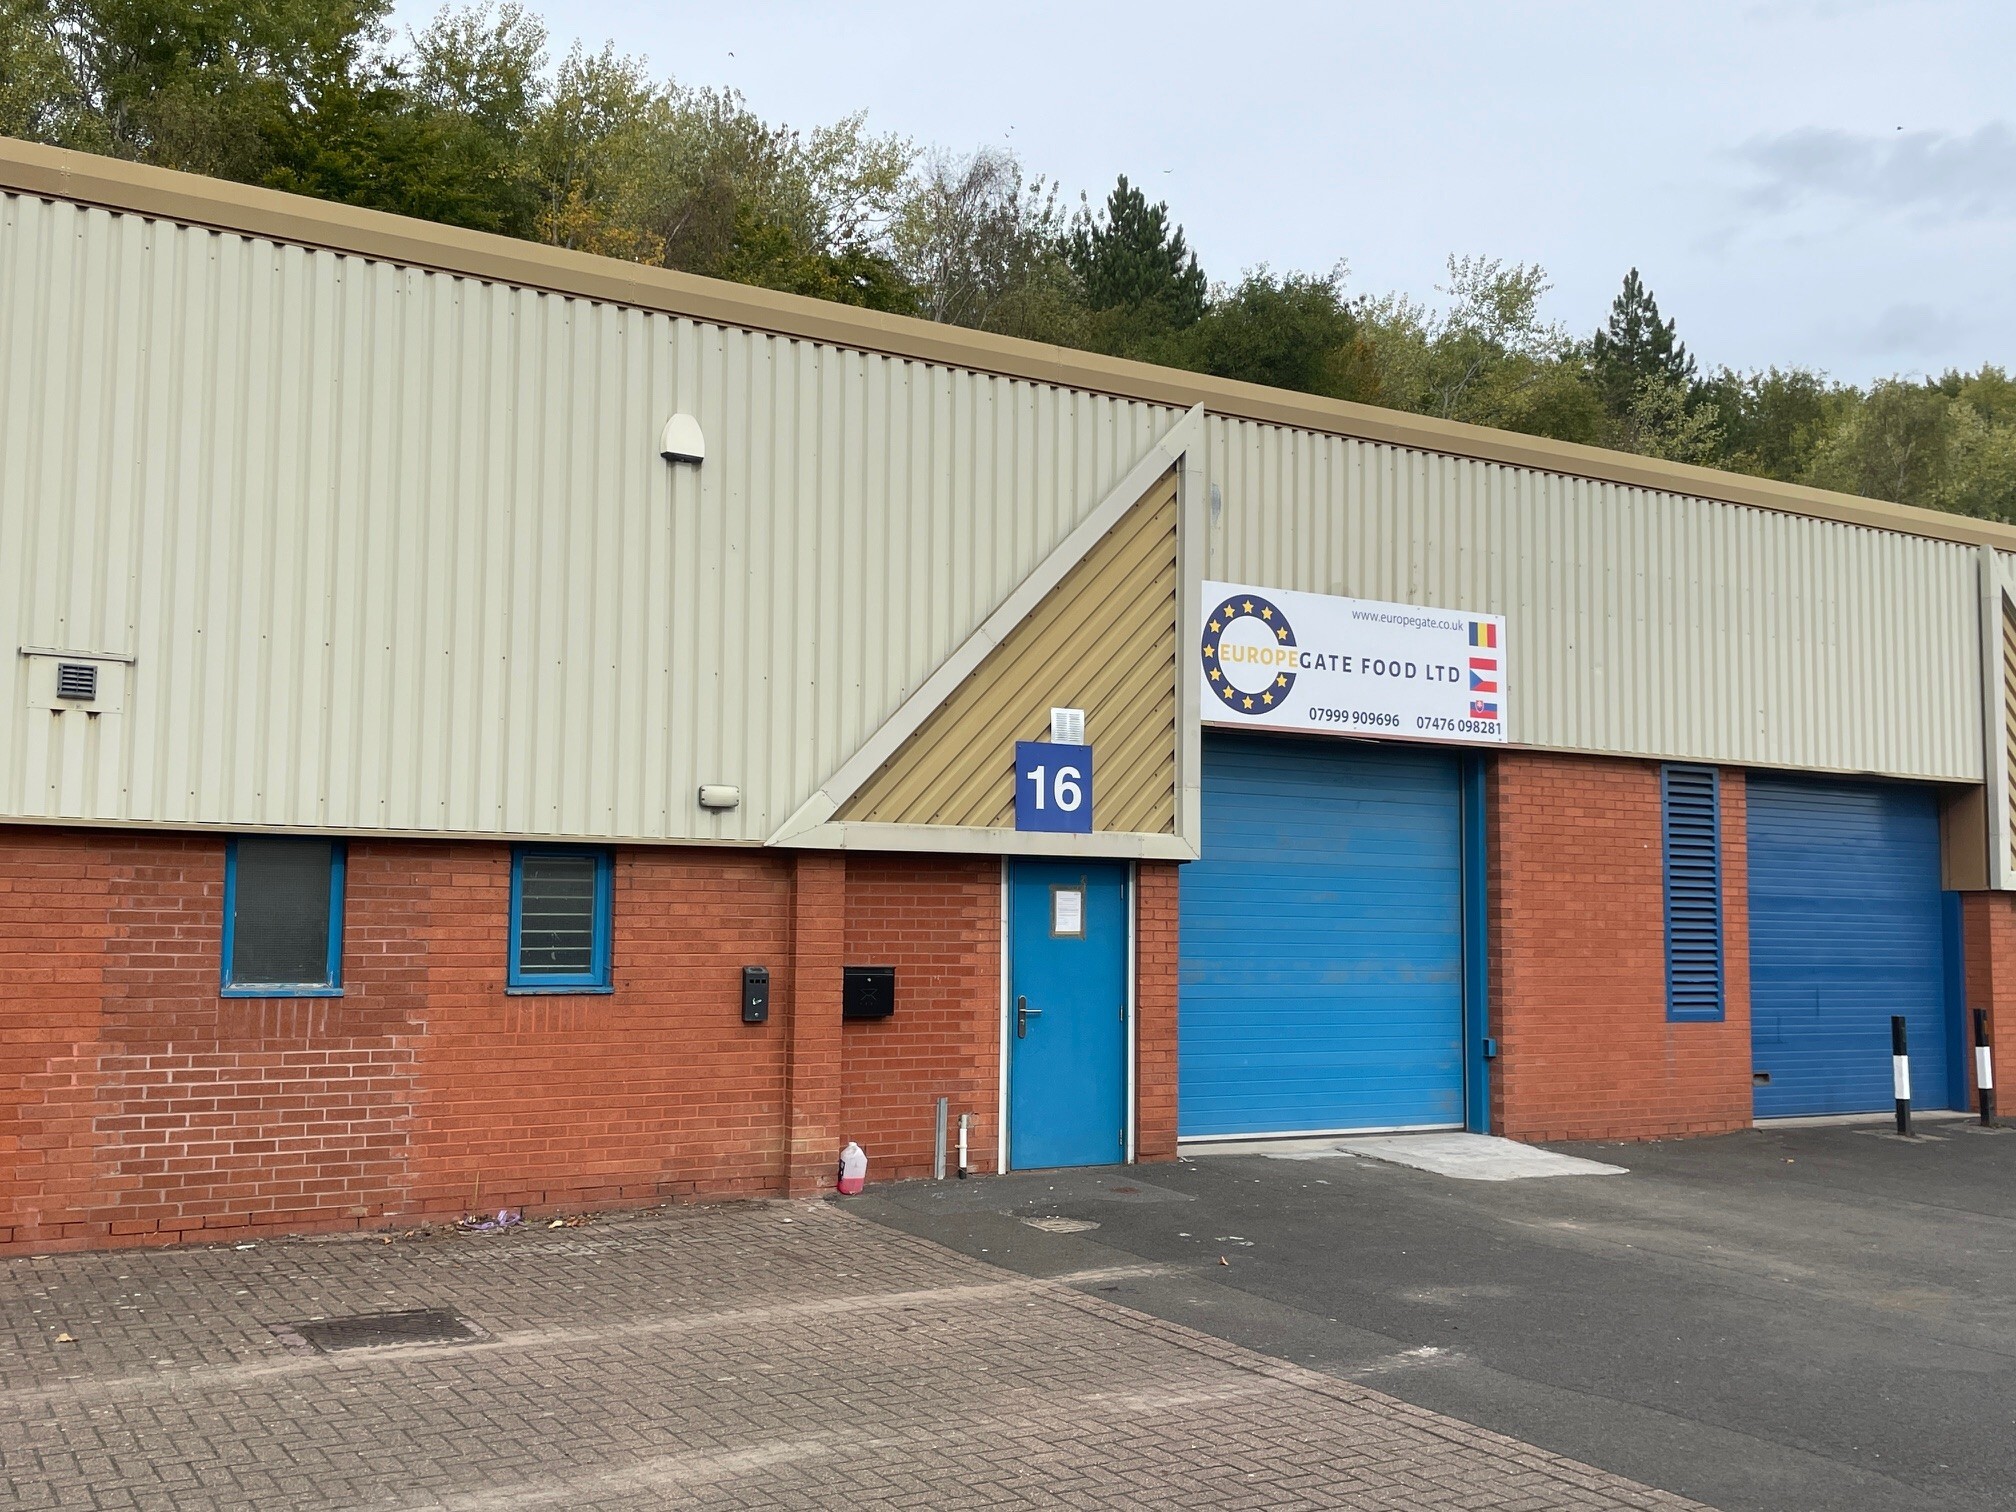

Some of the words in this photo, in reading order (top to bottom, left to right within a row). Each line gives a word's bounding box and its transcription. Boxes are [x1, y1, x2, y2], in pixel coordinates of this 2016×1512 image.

[1351, 610, 1464, 631] www.europegate.co.uk
[1361, 658, 1417, 679] FOOD
[1426, 664, 1460, 683] LTD
[1309, 707, 1349, 723] 07999
[1352, 711, 1400, 727] 909696
[1416, 716, 1455, 731] 07476
[1457, 719, 1501, 735] 098281
[1027, 765, 1082, 812] 16
